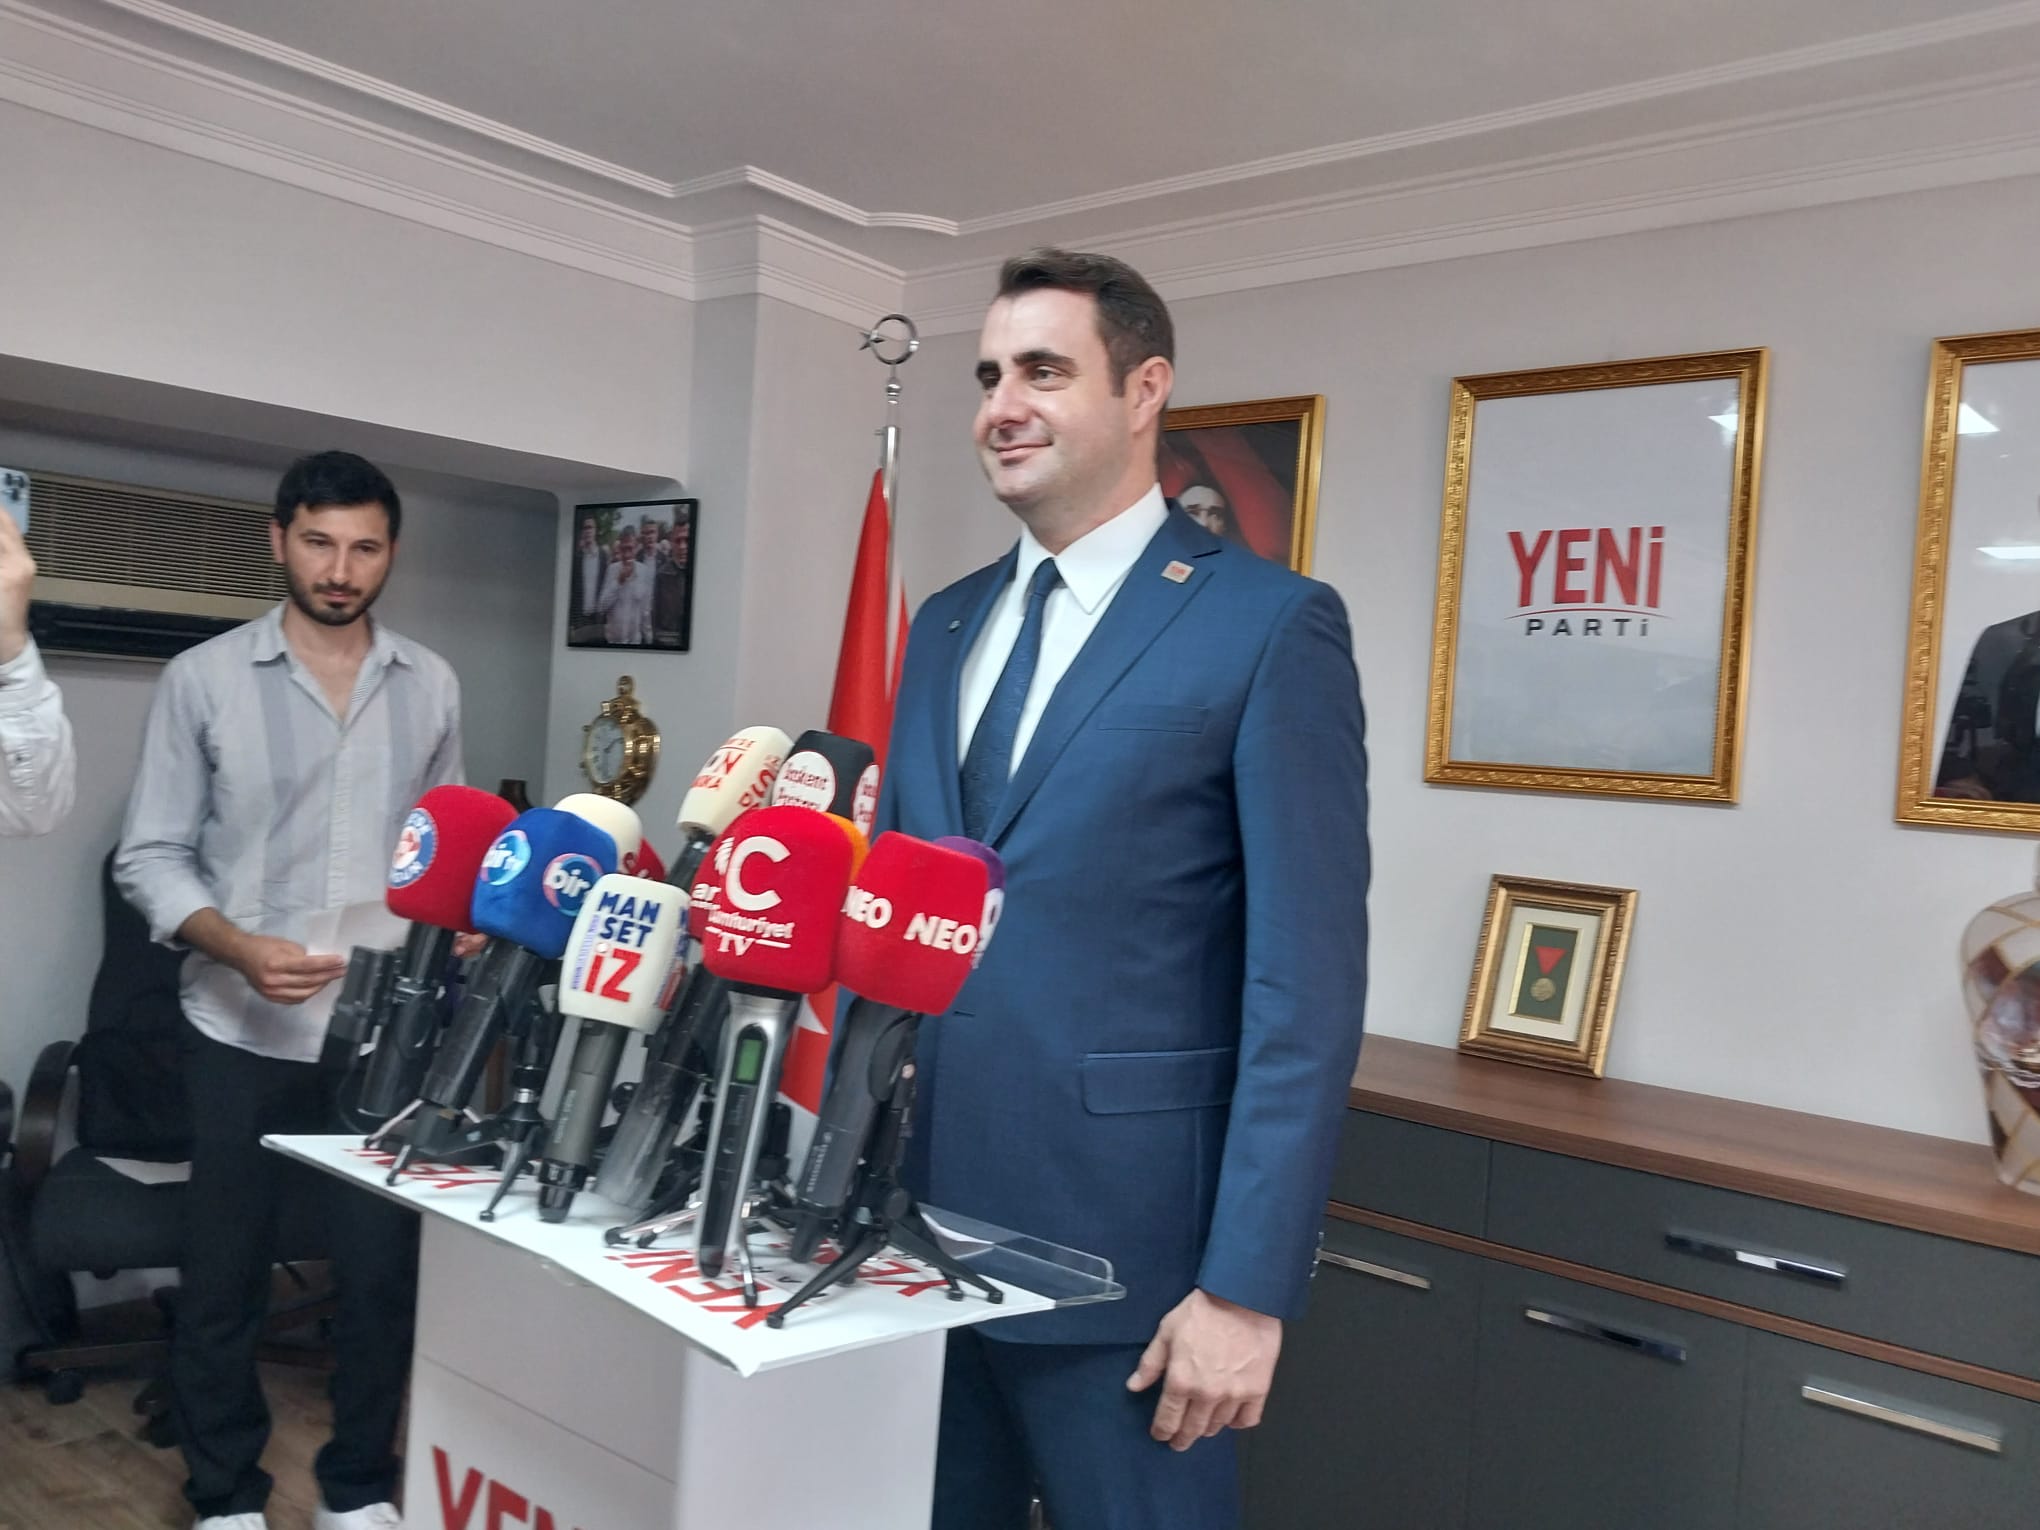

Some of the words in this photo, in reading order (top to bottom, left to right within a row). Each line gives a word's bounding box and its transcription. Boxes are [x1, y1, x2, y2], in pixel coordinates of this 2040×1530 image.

[726, 836, 791, 911] C
[598, 890, 662, 925] MAN
[599, 916, 653, 947] SET
[717, 931, 756, 956] TV
[904, 912, 978, 954] NEO
